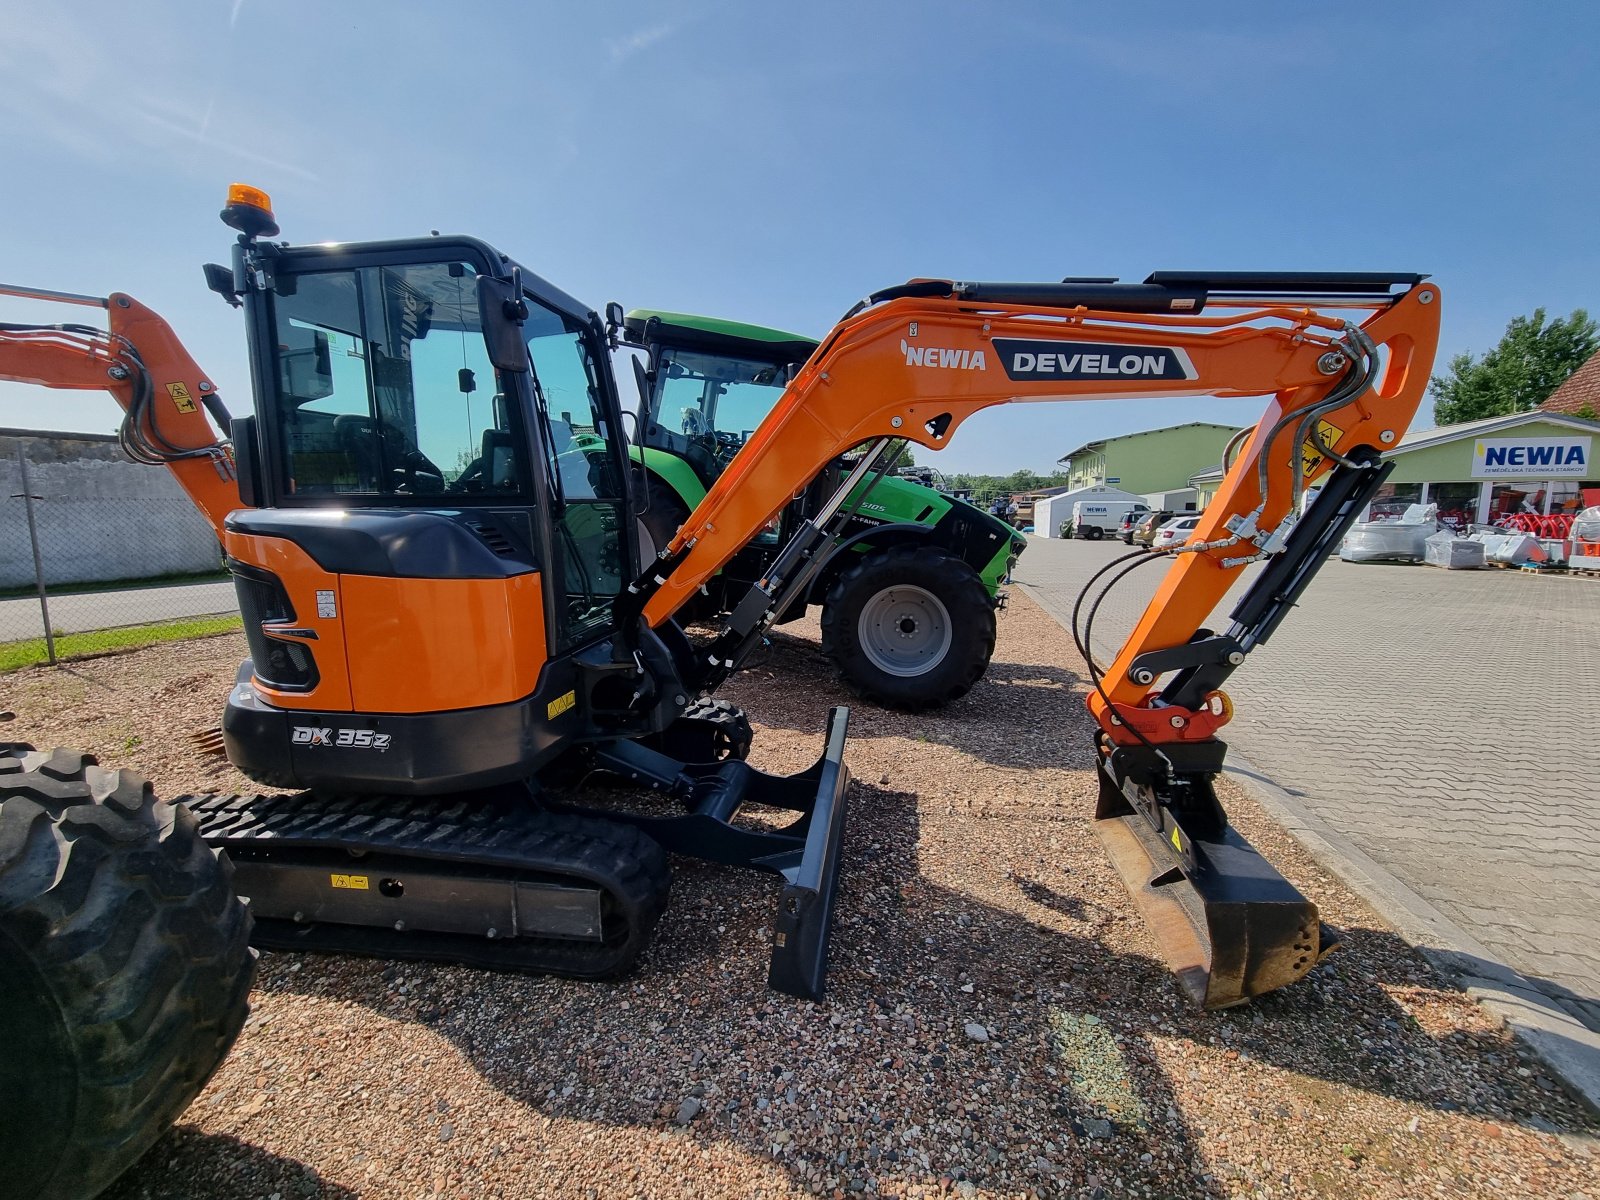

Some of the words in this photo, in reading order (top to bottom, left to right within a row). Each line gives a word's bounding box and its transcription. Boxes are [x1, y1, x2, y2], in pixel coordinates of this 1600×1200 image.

[905, 345, 986, 371] NEWIA
[1012, 352, 1166, 375] DEVELON
[1485, 445, 1585, 466] NEWIA
[292, 726, 333, 746] DX
